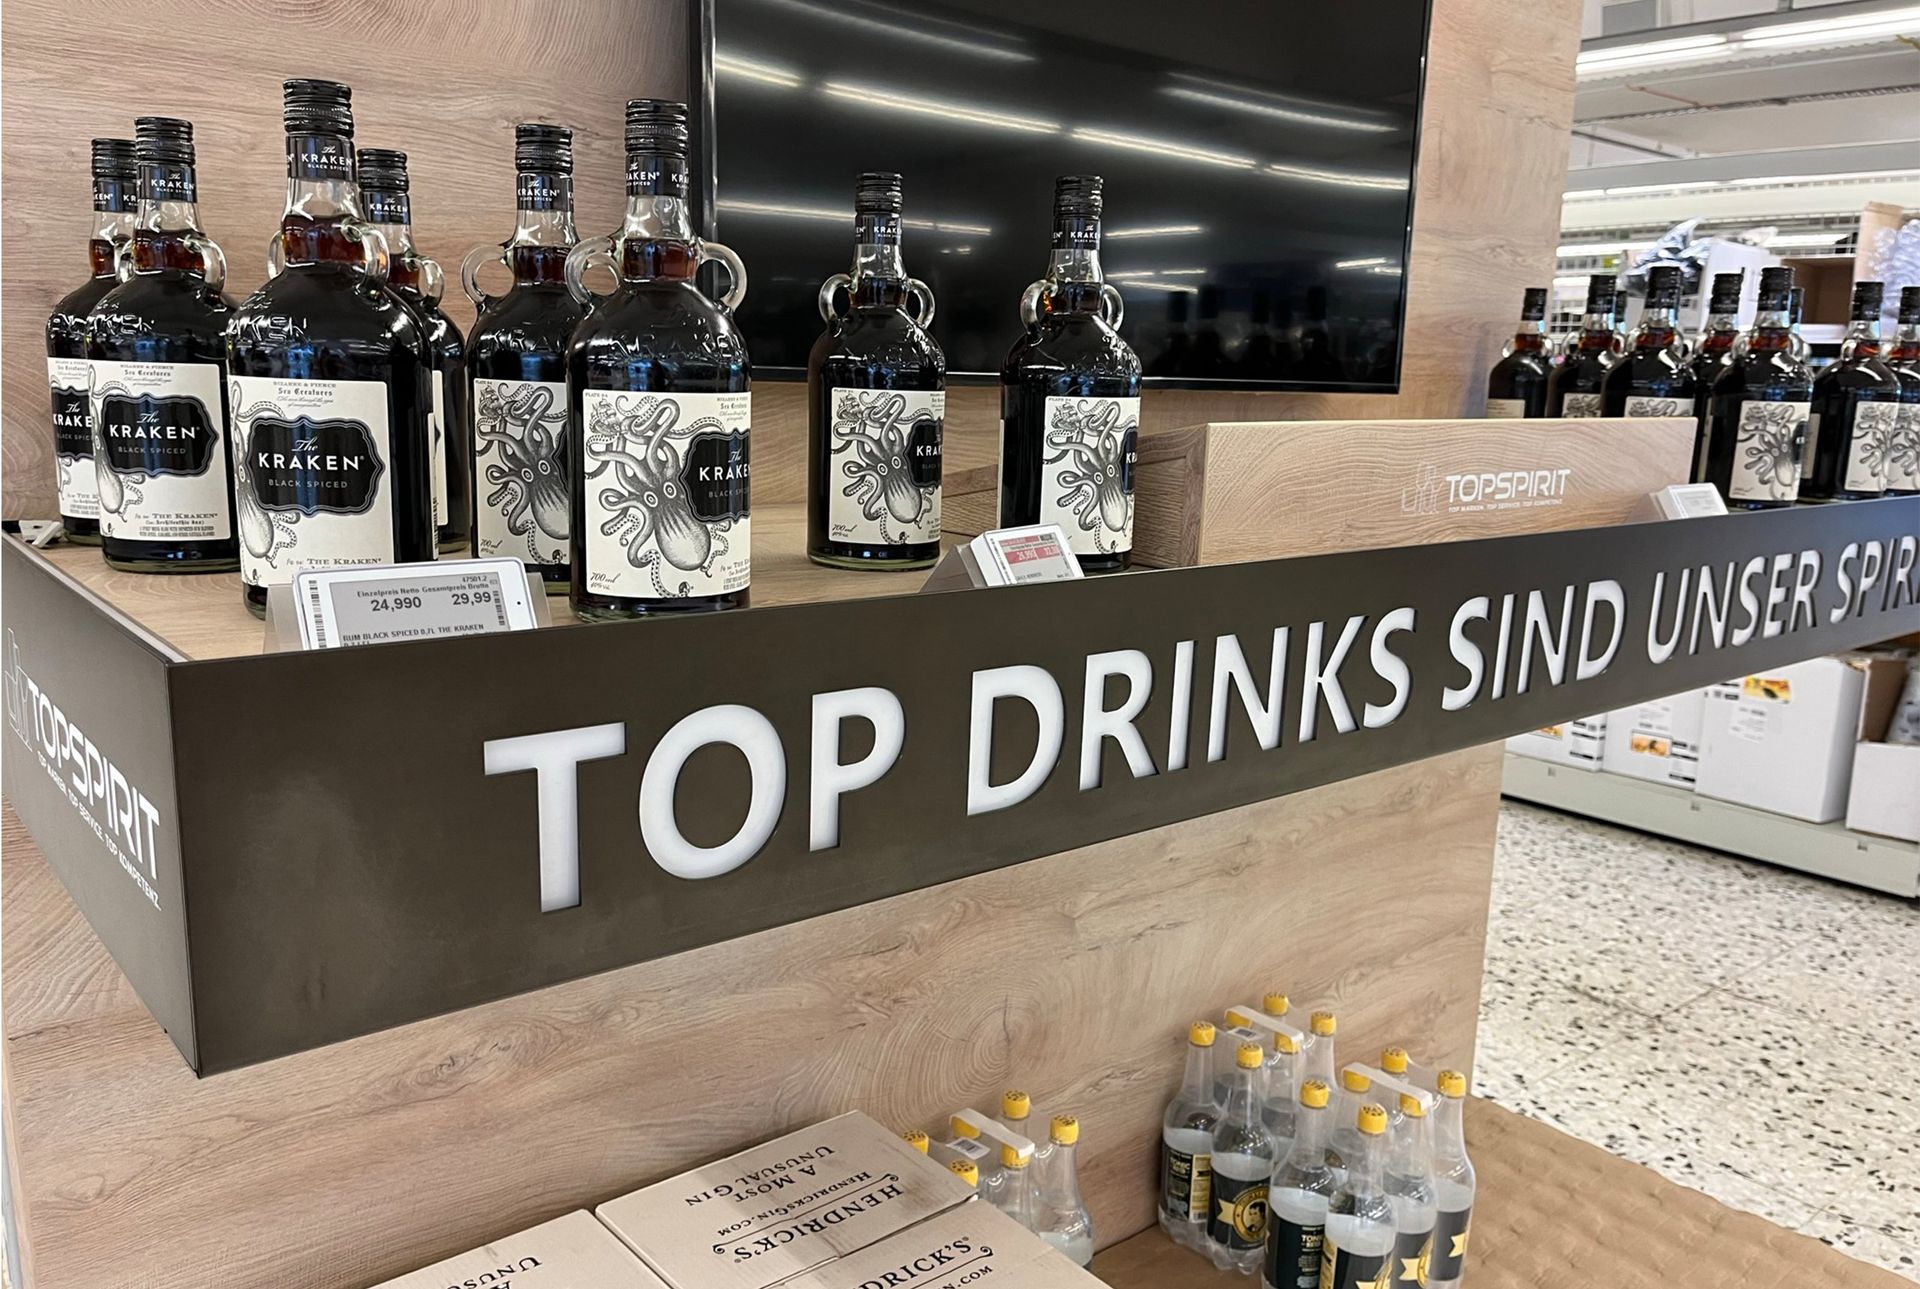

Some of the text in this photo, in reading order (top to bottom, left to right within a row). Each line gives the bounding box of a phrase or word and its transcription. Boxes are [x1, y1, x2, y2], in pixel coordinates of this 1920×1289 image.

[301, 153, 353, 166] KRAKEN
[151, 179, 195, 189] KRAKEN
[369, 203, 408, 212] KRAKEN
[136, 410, 160, 424] The
[109, 424, 196, 440] KRAKEN
[118, 446, 186, 454] BLACK SPICED
[292, 436, 318, 452] The
[258, 452, 359, 471] KRAKEN
[699, 463, 750, 481] KRAKE
[268, 479, 348, 489] BLACK SPICED
[1445, 468, 1572, 503] TOPSPIRIT
[421, 584, 467, 595] Gesamtpreis
[370, 591, 492, 613] 24,990 29,99
[342, 634, 362, 642] RUM
[363, 631, 390, 640] BLACK
[391, 628, 420, 638] SPICED
[437, 626, 451, 634] THE
[454, 623, 485, 632] KRAKEN
[484, 535, 1920, 913] TOP DRINKS SIND UNSER SPIR
[28, 676, 160, 881] TOPSPIRIT
[104, 833, 118, 856] TOP
[688, 1145, 836, 1206] UNUSUAL GIN
[734, 1164, 817, 1202] A MOST
[733, 1184, 905, 1262] HENDRICK'S
